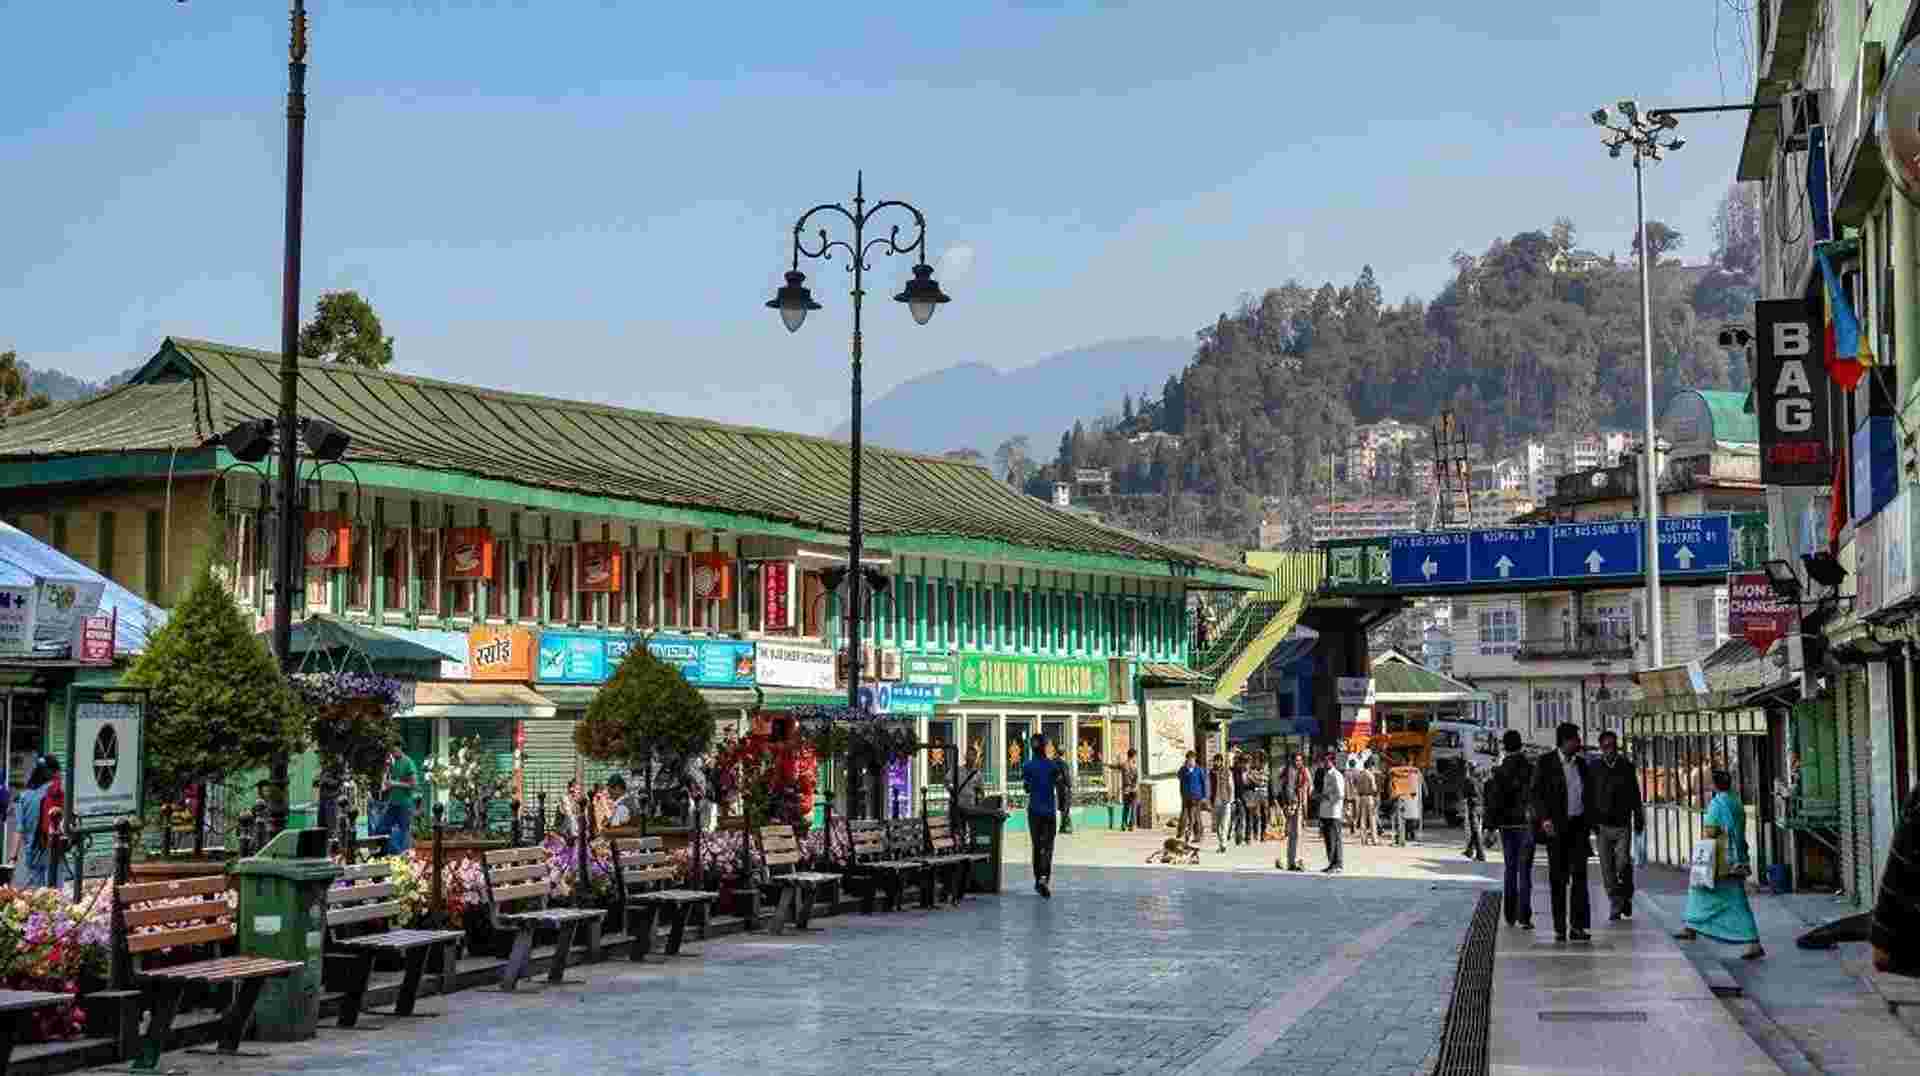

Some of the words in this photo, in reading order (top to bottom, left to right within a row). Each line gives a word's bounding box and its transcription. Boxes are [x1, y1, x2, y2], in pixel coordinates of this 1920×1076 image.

[1773, 322, 1812, 432] BAG
[980, 661, 1028, 695] SIKKIM
[1034, 663, 1091, 696] TOURISM
